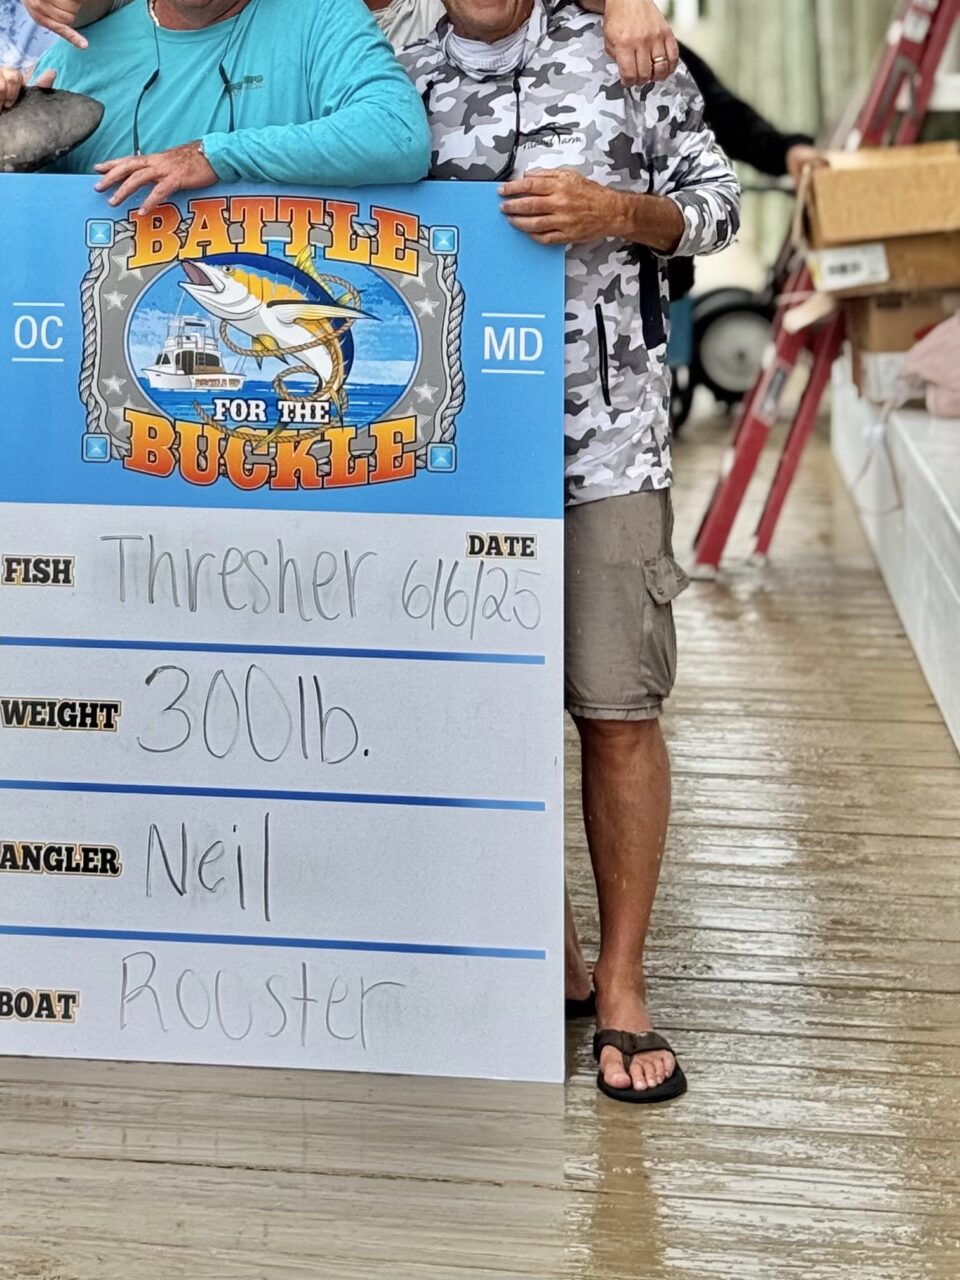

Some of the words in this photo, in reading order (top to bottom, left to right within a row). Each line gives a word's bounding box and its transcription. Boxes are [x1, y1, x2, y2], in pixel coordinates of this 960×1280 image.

[127, 195, 420, 276] BATTLE
[13, 315, 64, 350] OC
[483, 326, 543, 362] MD
[213, 398, 267, 422] FOR
[277, 400, 330, 423] THE
[123, 407, 417, 490] BUCKLE
[467, 533, 537, 558] DATE
[2, 556, 73, 586] FISH
[100, 533, 378, 622] Thresher
[402, 558, 541, 639] 6/6/25
[0, 699, 120, 730] WEIGHT
[146, 812, 270, 922] Neil
